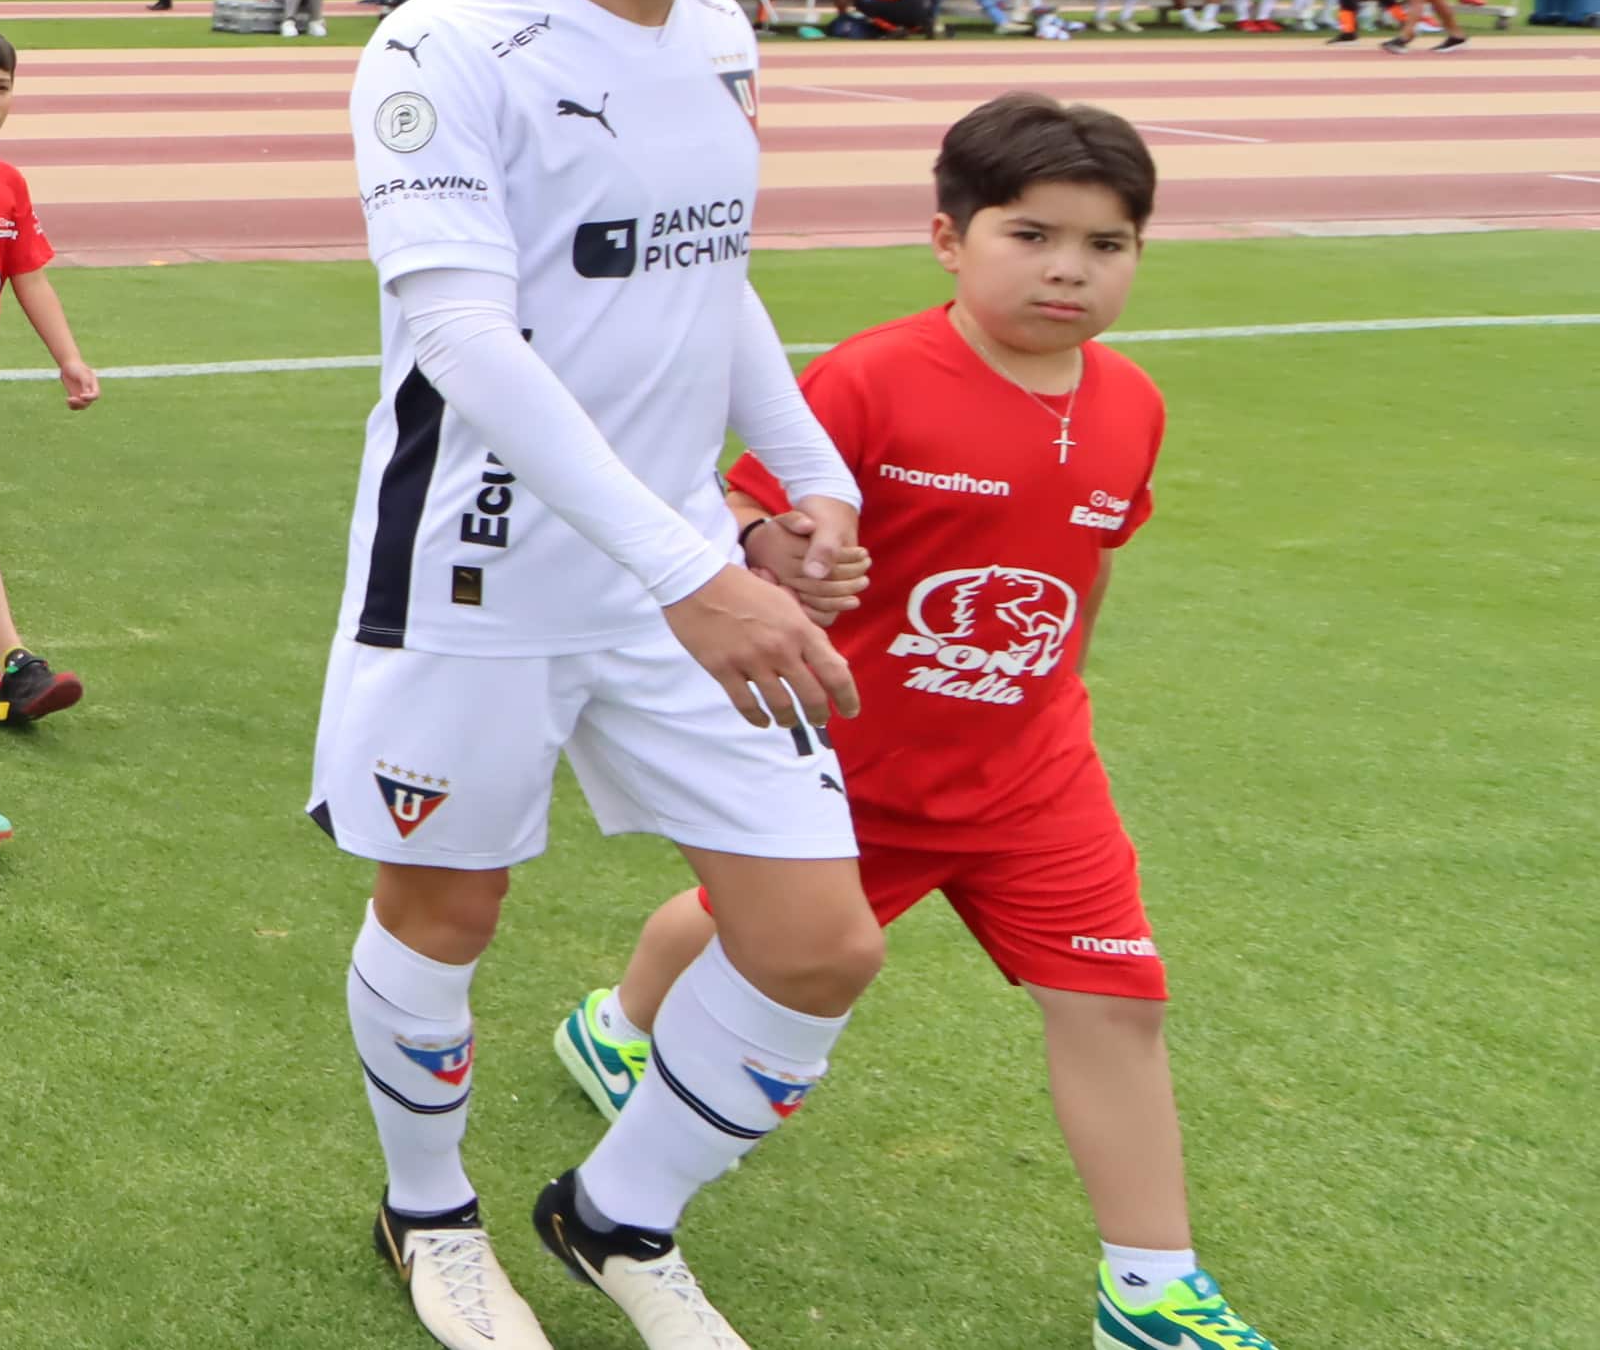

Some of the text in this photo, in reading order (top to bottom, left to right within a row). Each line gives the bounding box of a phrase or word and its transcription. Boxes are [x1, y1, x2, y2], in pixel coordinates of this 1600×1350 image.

[651, 198, 744, 239] BANCO
[645, 231, 751, 272] PICHINC
[880, 463, 1010, 497] marathon
[886, 633, 1064, 678] PONY
[903, 665, 1025, 706] Malta
[394, 786, 425, 821] U
